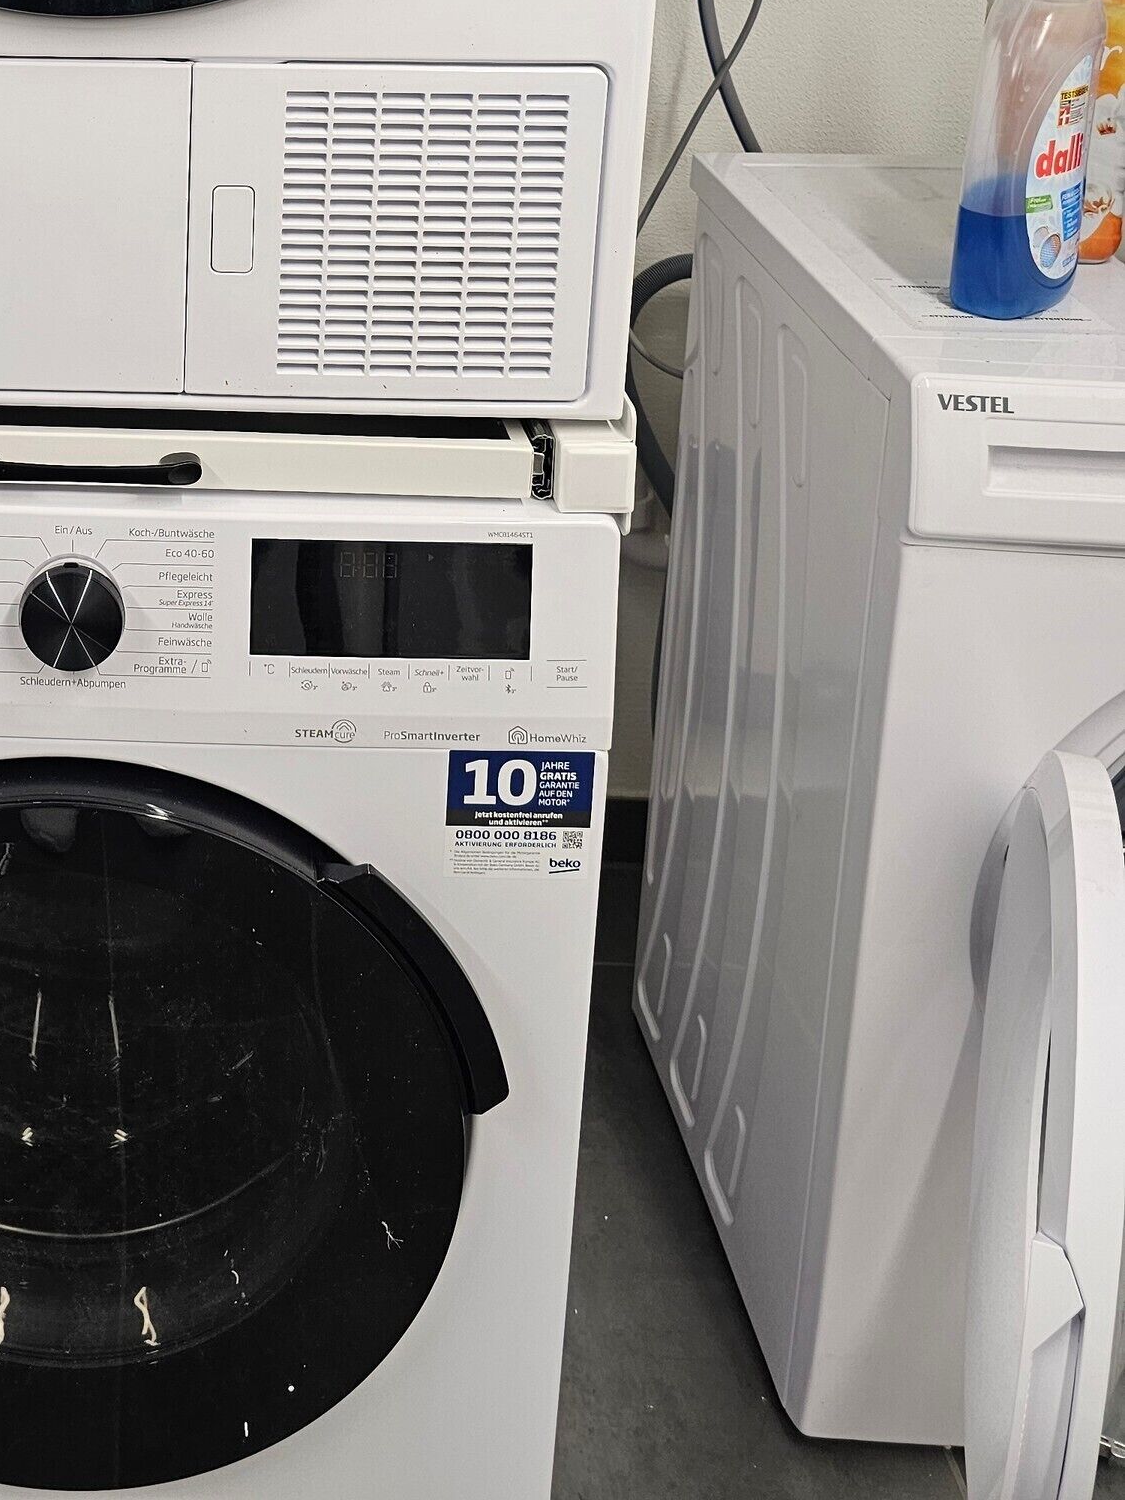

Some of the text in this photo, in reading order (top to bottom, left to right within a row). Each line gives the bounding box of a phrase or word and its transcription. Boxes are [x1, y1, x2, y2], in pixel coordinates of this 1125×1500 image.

[1035, 132, 1084, 179] dalli
[937, 393, 1015, 414] VESTEL
[54, 525, 93, 535] Ein Aus
[129, 528, 215, 540] Koch-/Buntwäsche
[165, 549, 183, 559] Eco
[159, 571, 213, 583] Pflegeleicht
[177, 590, 213, 600] Express
[177, 599, 202, 607] Express
[188, 612, 213, 622] Wolle
[171, 621, 213, 630] Handwäsche
[158, 637, 212, 648] Feinwäsche
[159, 656, 187, 667] Extra-
[133, 664, 187, 676] Programme
[291, 666, 328, 675] Schleudern
[331, 666, 368, 675] Vorwäsche
[378, 668, 401, 676] Steam
[414, 668, 444, 677] Schnell+
[456, 665, 484, 673] Zeitvor-
[556, 666, 578, 674] Start/
[20, 676, 126, 689] Schleudern+Abpumpen
[461, 674, 479, 682] wahl
[556, 674, 578, 682] Pause
[383, 729, 481, 742] ProSmartInverter
[529, 733, 587, 744] HomeWhiz
[541, 761, 570, 771] JAHRE
[540, 772, 577, 781] GRATIS
[463, 759, 537, 806] 10
[539, 781, 580, 789] GARANTIE
[538, 790, 573, 798] AUF DEN
[475, 811, 563, 820] Jetzt kostenfrei anrufen
[455, 830, 557, 841] 0800 000 8186
[549, 858, 581, 868] beko
